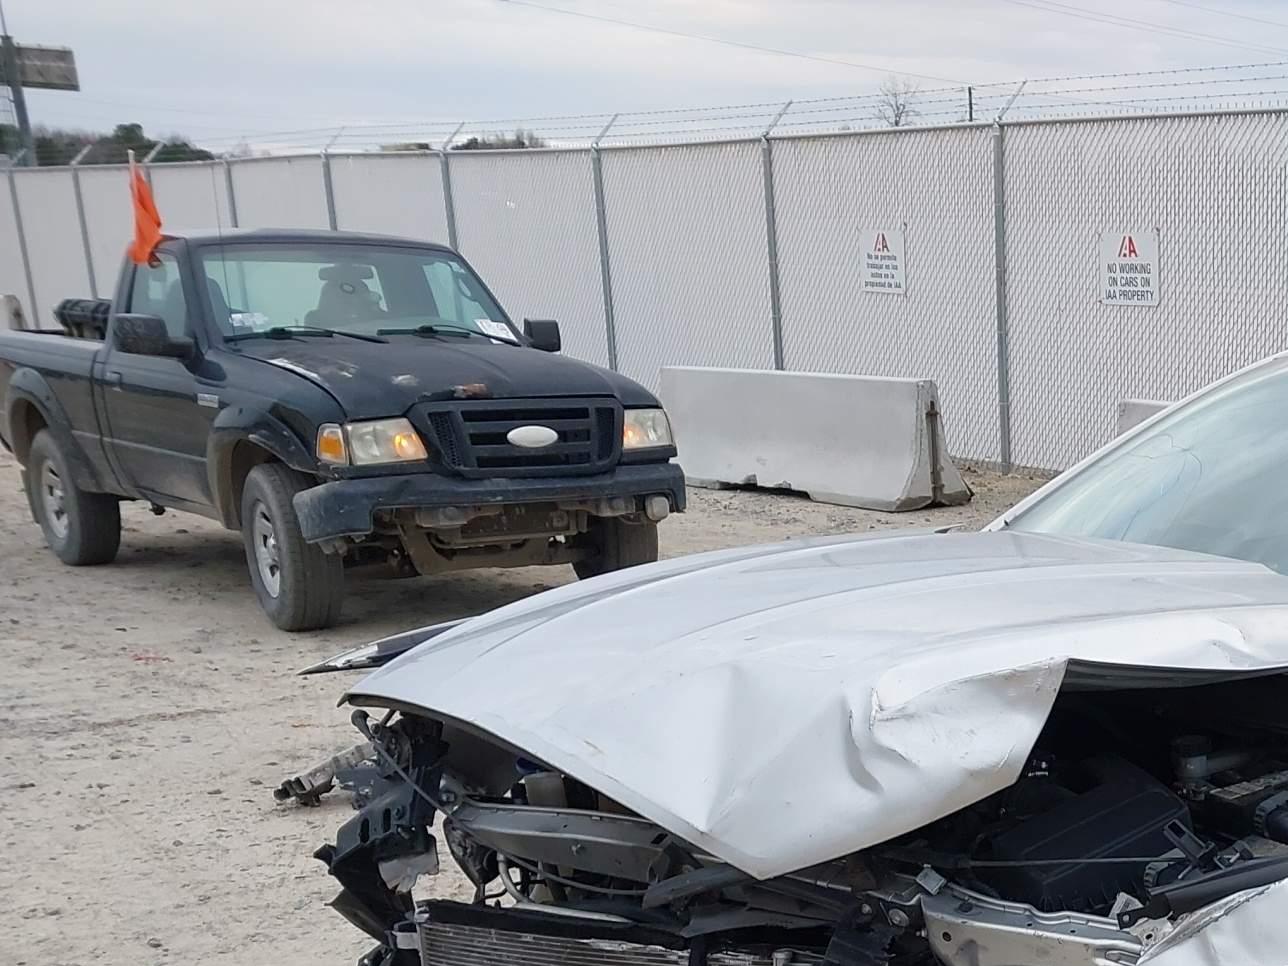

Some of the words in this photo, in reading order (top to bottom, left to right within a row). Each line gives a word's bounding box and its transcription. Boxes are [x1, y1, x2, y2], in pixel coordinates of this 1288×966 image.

[1107, 263, 1117, 274] NO
[1118, 263, 1151, 274] WORKING
[1108, 276, 1118, 287] ON
[1119, 276, 1138, 287] CARS
[1140, 276, 1150, 287] ON
[1105, 289, 1117, 300] IAA
[1118, 289, 1154, 301] PROPERTY
